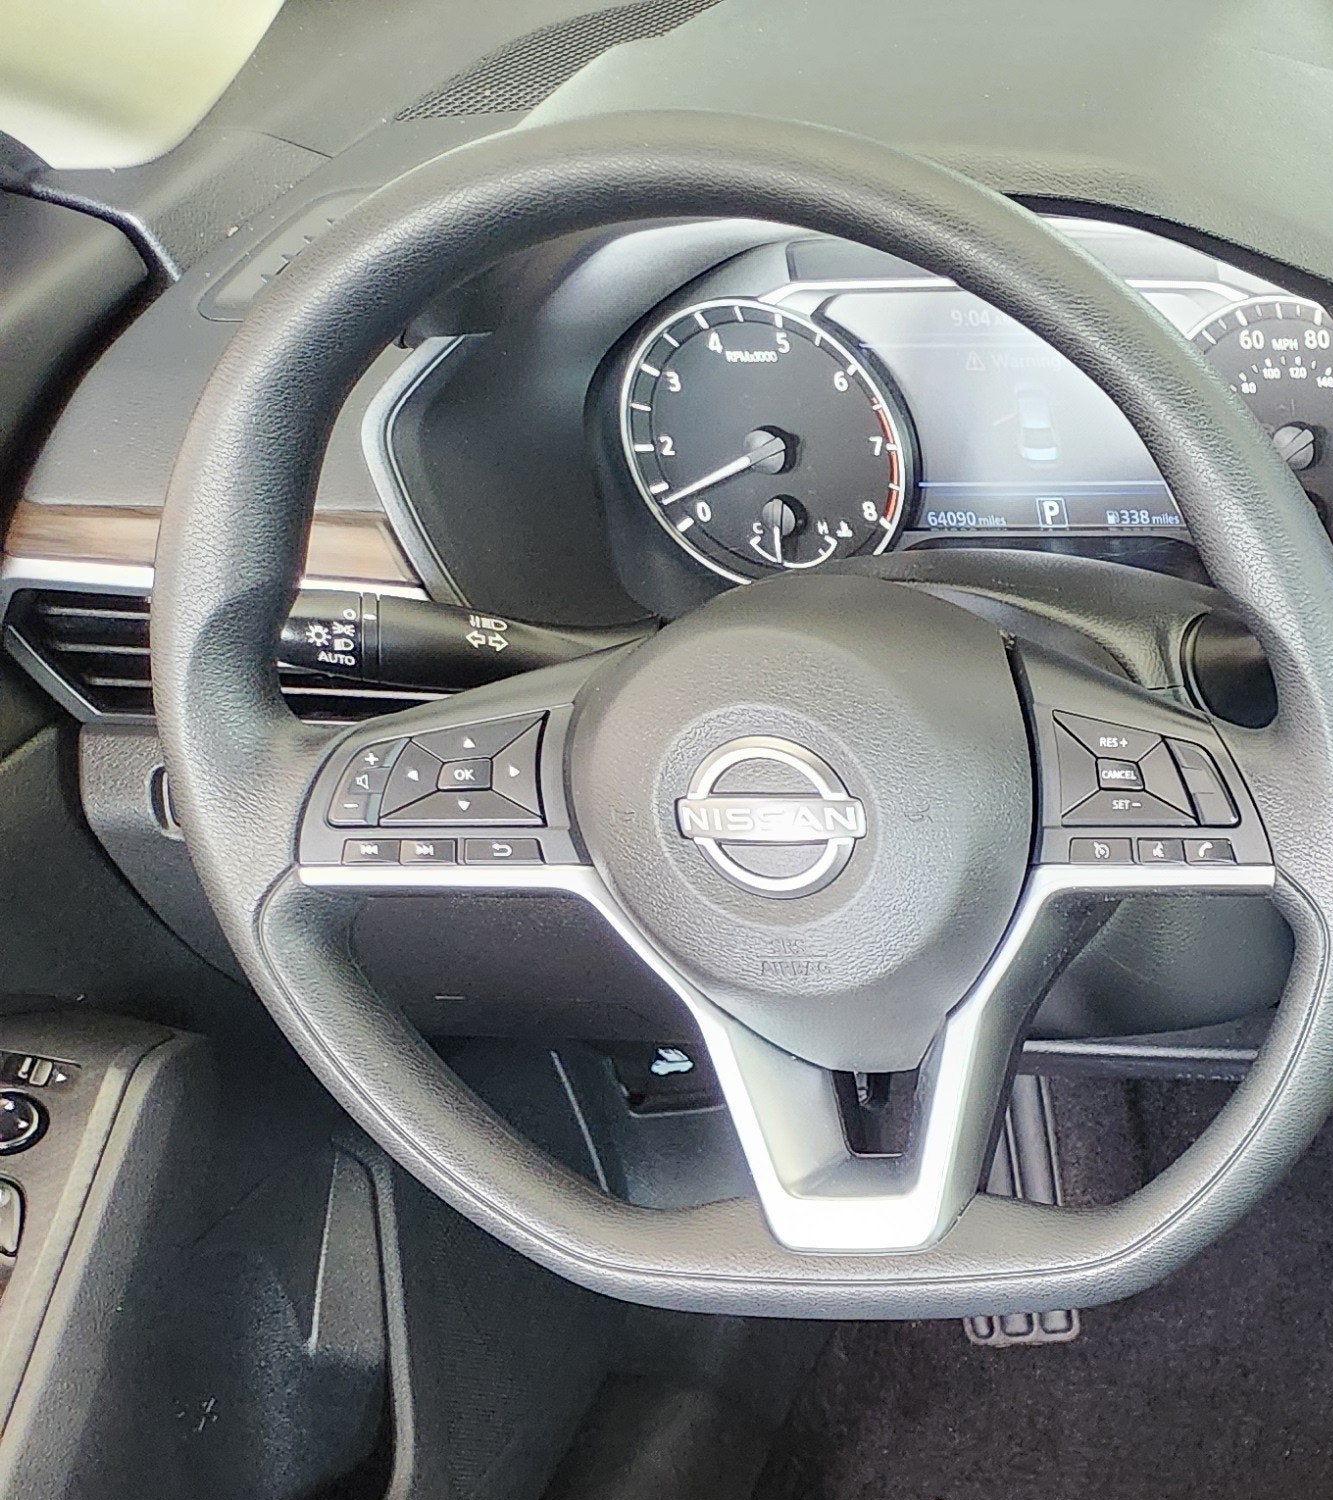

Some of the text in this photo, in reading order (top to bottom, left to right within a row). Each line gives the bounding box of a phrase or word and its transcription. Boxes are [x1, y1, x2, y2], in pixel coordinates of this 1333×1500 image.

[949, 309, 990, 327] 9:04
[708, 332, 723, 353] 4
[775, 333, 790, 353] 5
[1239, 330, 1264, 350] 60
[1271, 338, 1298, 351] MPH
[1304, 330, 1330, 350] 80
[665, 371, 681, 391] 3
[833, 371, 848, 391] 6
[659, 436, 675, 455] 2
[869, 436, 882, 456] 7
[696, 501, 711, 522] 0
[862, 501, 877, 520] 8
[927, 511, 1006, 527] 64090 miles
[1042, 500, 1059, 524] P
[1120, 510, 1180, 525] 338 miles
[752, 522, 763, 534] C
[317, 651, 356, 667] AUTO
[454, 768, 476, 781] OK
[1101, 769, 1137, 780] CANCEL
[682, 806, 858, 832] NISSAN
